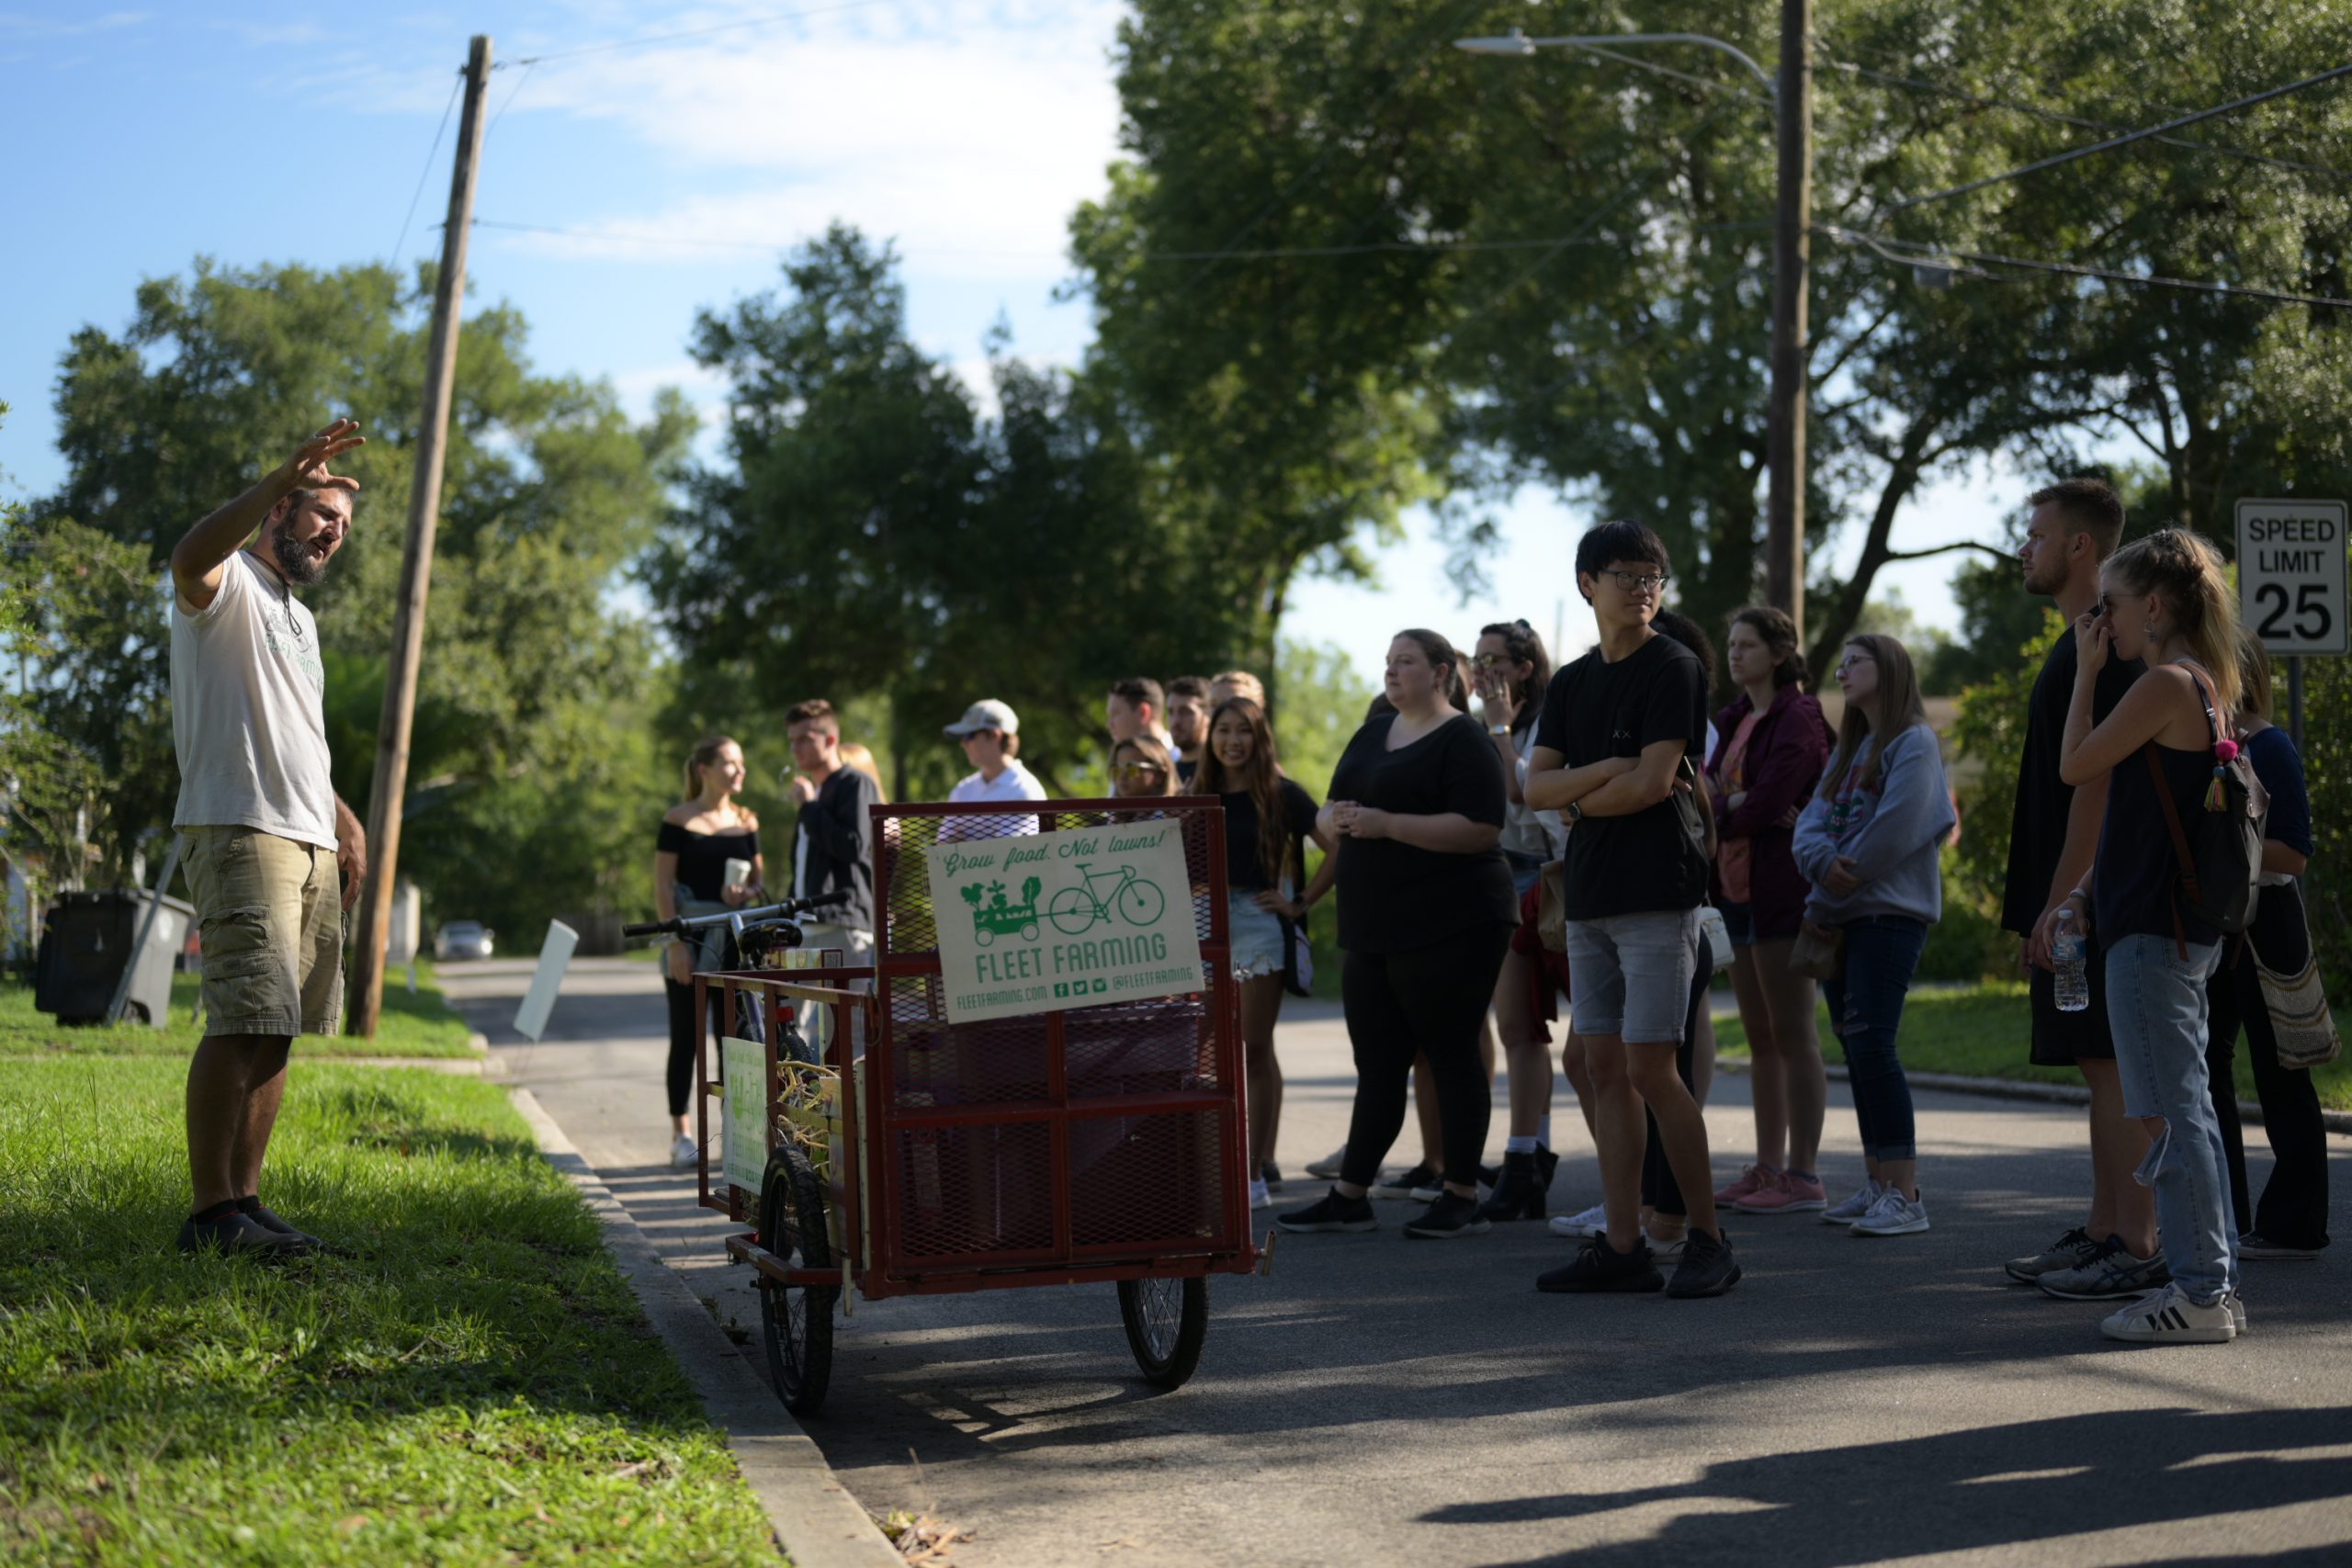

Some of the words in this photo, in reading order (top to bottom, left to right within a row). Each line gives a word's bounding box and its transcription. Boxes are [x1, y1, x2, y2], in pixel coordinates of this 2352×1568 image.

[2249, 518, 2335, 542] SPEED
[2259, 550, 2324, 573] LIMIT
[2255, 581, 2332, 640] 25
[943, 852, 994, 877] Grow
[1002, 842, 1051, 873] food.
[1057, 838, 1099, 859] Not
[1108, 830, 1166, 853] lawns!
[976, 947, 1043, 984] FLEET
[1052, 932, 1167, 974] FARMING
